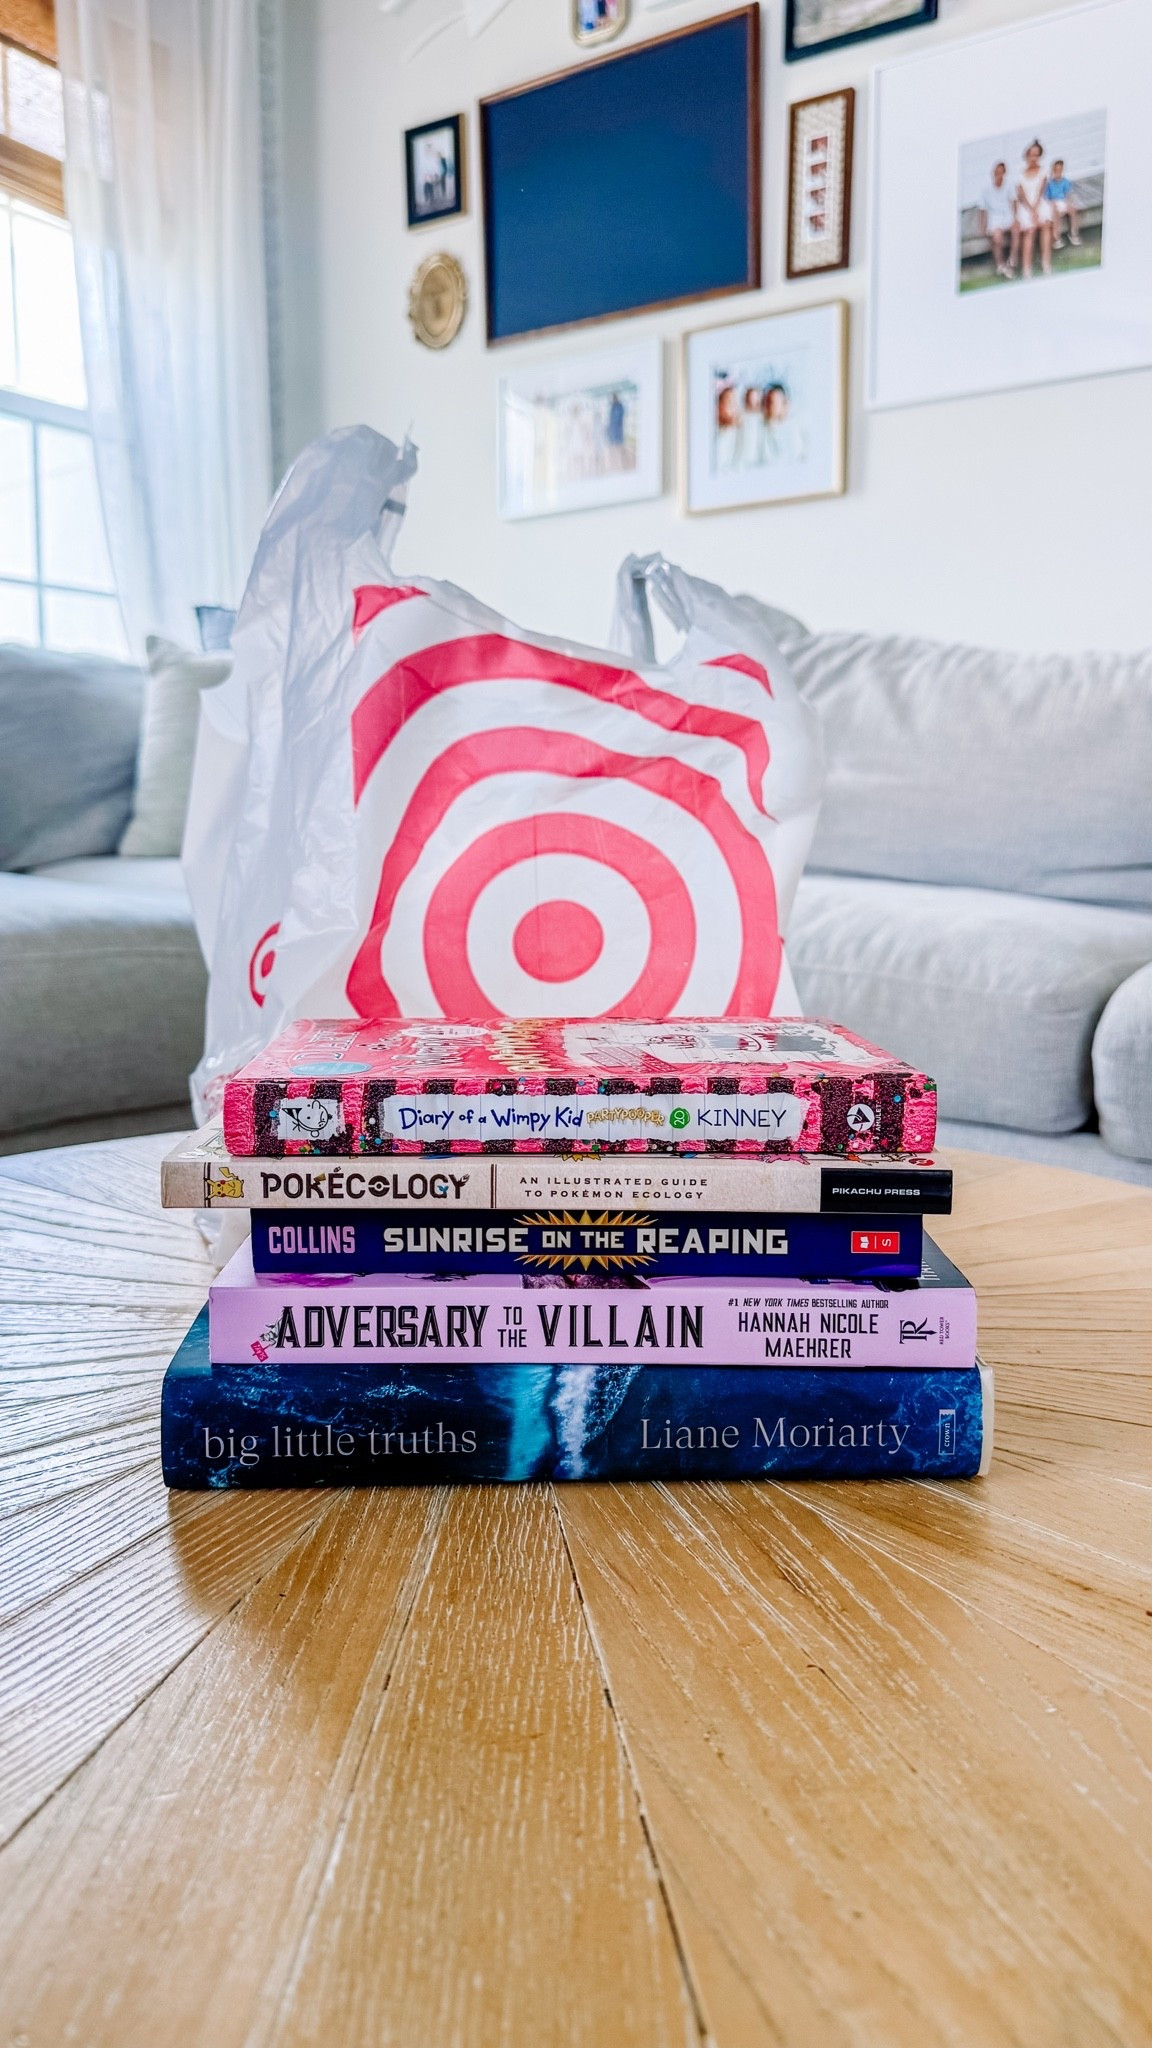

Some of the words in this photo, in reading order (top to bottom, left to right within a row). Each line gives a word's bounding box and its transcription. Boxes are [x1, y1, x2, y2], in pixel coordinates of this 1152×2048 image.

[399, 1106, 454, 1130] Diary
[458, 1109, 474, 1124] of
[478, 1115, 487, 1125] a
[491, 1108, 550, 1131] Wimpy
[555, 1107, 583, 1128] Kid
[697, 1108, 787, 1127] KINNEY
[260, 1166, 470, 1200] POKÉCOLOGY
[520, 1177, 537, 1185] AN
[547, 1177, 653, 1186] ILLUSTRATED
[661, 1178, 708, 1187] GUIDE
[832, 1187, 882, 1196] PIKACHU
[884, 1188, 921, 1196] PRESS
[525, 1190, 544, 1198] TO
[551, 1188, 623, 1199] POKÉMON
[632, 1190, 704, 1200] ECOLOGY
[268, 1225, 355, 1254] COLLINS
[383, 1227, 529, 1253] SUNRISE
[541, 1230, 571, 1249] ON
[580, 1230, 625, 1250] THE
[636, 1228, 789, 1255] REAPING
[728, 1298, 739, 1307] #1
[743, 1298, 761, 1307] NEW
[764, 1298, 783, 1307] YORK
[786, 1298, 809, 1308] TIMES
[811, 1299, 857, 1308] BESTSELLING
[861, 1299, 889, 1309] AUTHOR
[276, 1304, 490, 1348] ADVERSARY
[503, 1306, 522, 1326] TO
[537, 1304, 704, 1348] VILLAIN
[738, 1312, 810, 1333] HANNAH
[820, 1313, 879, 1334] NICOLE
[497, 1328, 527, 1348] THE
[765, 1337, 852, 1358] MAEHRER
[202, 1427, 259, 1466] big
[271, 1424, 355, 1458] little
[369, 1422, 477, 1456] truths
[640, 1418, 740, 1450] Liane
[752, 1416, 911, 1455] Moriarty
